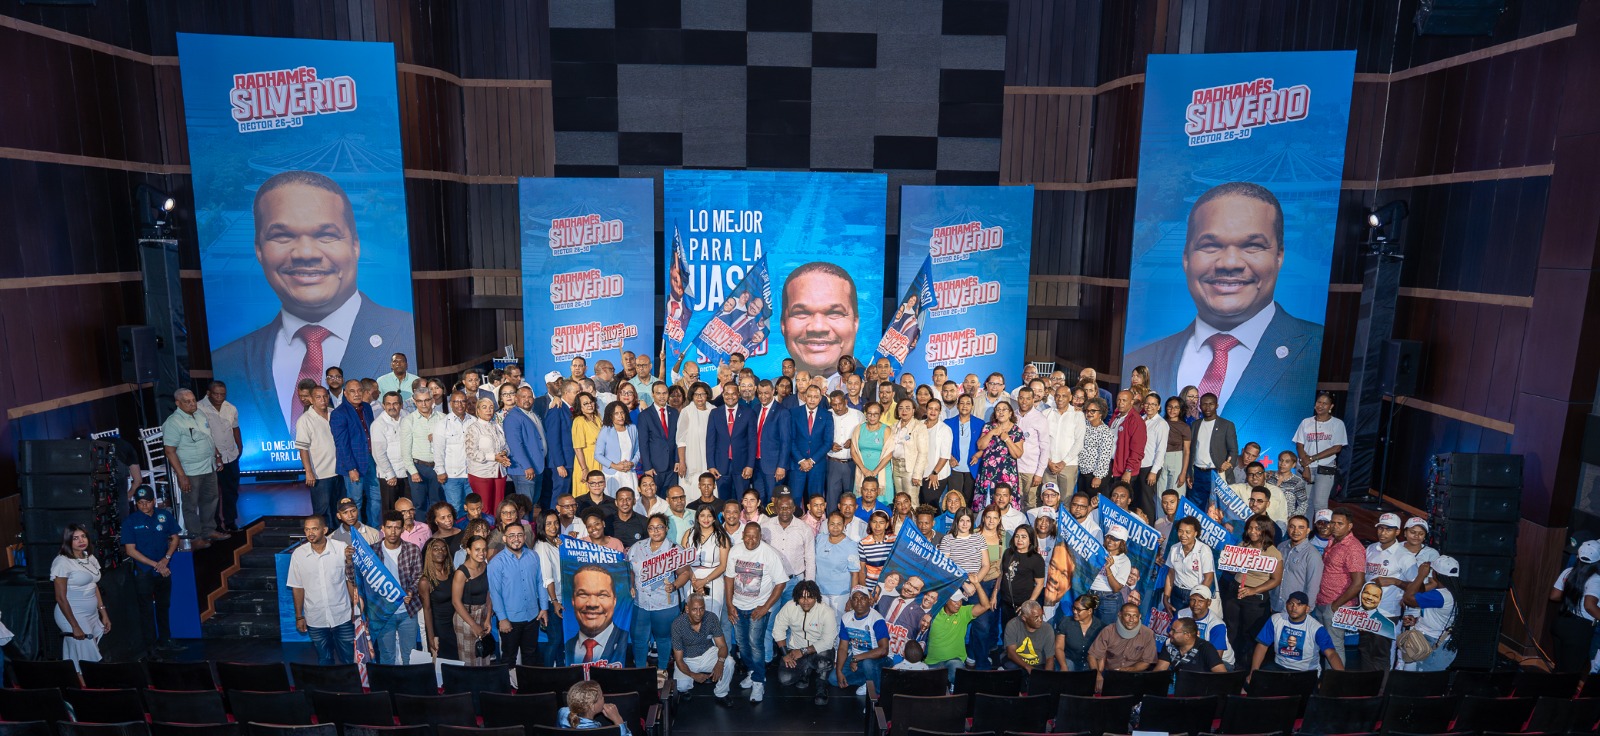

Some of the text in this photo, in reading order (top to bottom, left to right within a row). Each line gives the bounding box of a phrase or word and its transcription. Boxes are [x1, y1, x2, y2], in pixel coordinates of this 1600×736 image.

[231, 77, 357, 121] SILVERIO
[1186, 86, 1309, 136] SILVERIO
[240, 118, 301, 131] RECTOR 26-30
[1190, 129, 1250, 145] RECTOR 26-30
[689, 209, 763, 233] LO MEJOR
[550, 221, 623, 249] SILVERIO
[930, 227, 1003, 257] SILVERIO
[689, 238, 733, 261] PARA
[742, 238, 762, 261] LA
[550, 276, 623, 303] SILVERIO
[689, 264, 757, 311] UAS
[926, 333, 998, 362] SILVERIO
[699, 365, 718, 373] RECTO
[261, 440, 296, 451] LO MEJO
[270, 451, 302, 462] PARA LA
[1102, 503, 1129, 527] LO MEJOR
[1183, 502, 1194, 517] EN
[906, 527, 916, 539] LO
[1067, 519, 1079, 535] LA
[1128, 520, 1159, 551] UASD
[564, 538, 577, 549] EN
[577, 540, 590, 550] LA
[907, 541, 932, 561] PARA LA
[640, 547, 697, 583] SILVERIO
[1219, 551, 1278, 573] SILVERIO
[365, 565, 401, 603] UASD
[1333, 612, 1383, 633] SILVERIO
